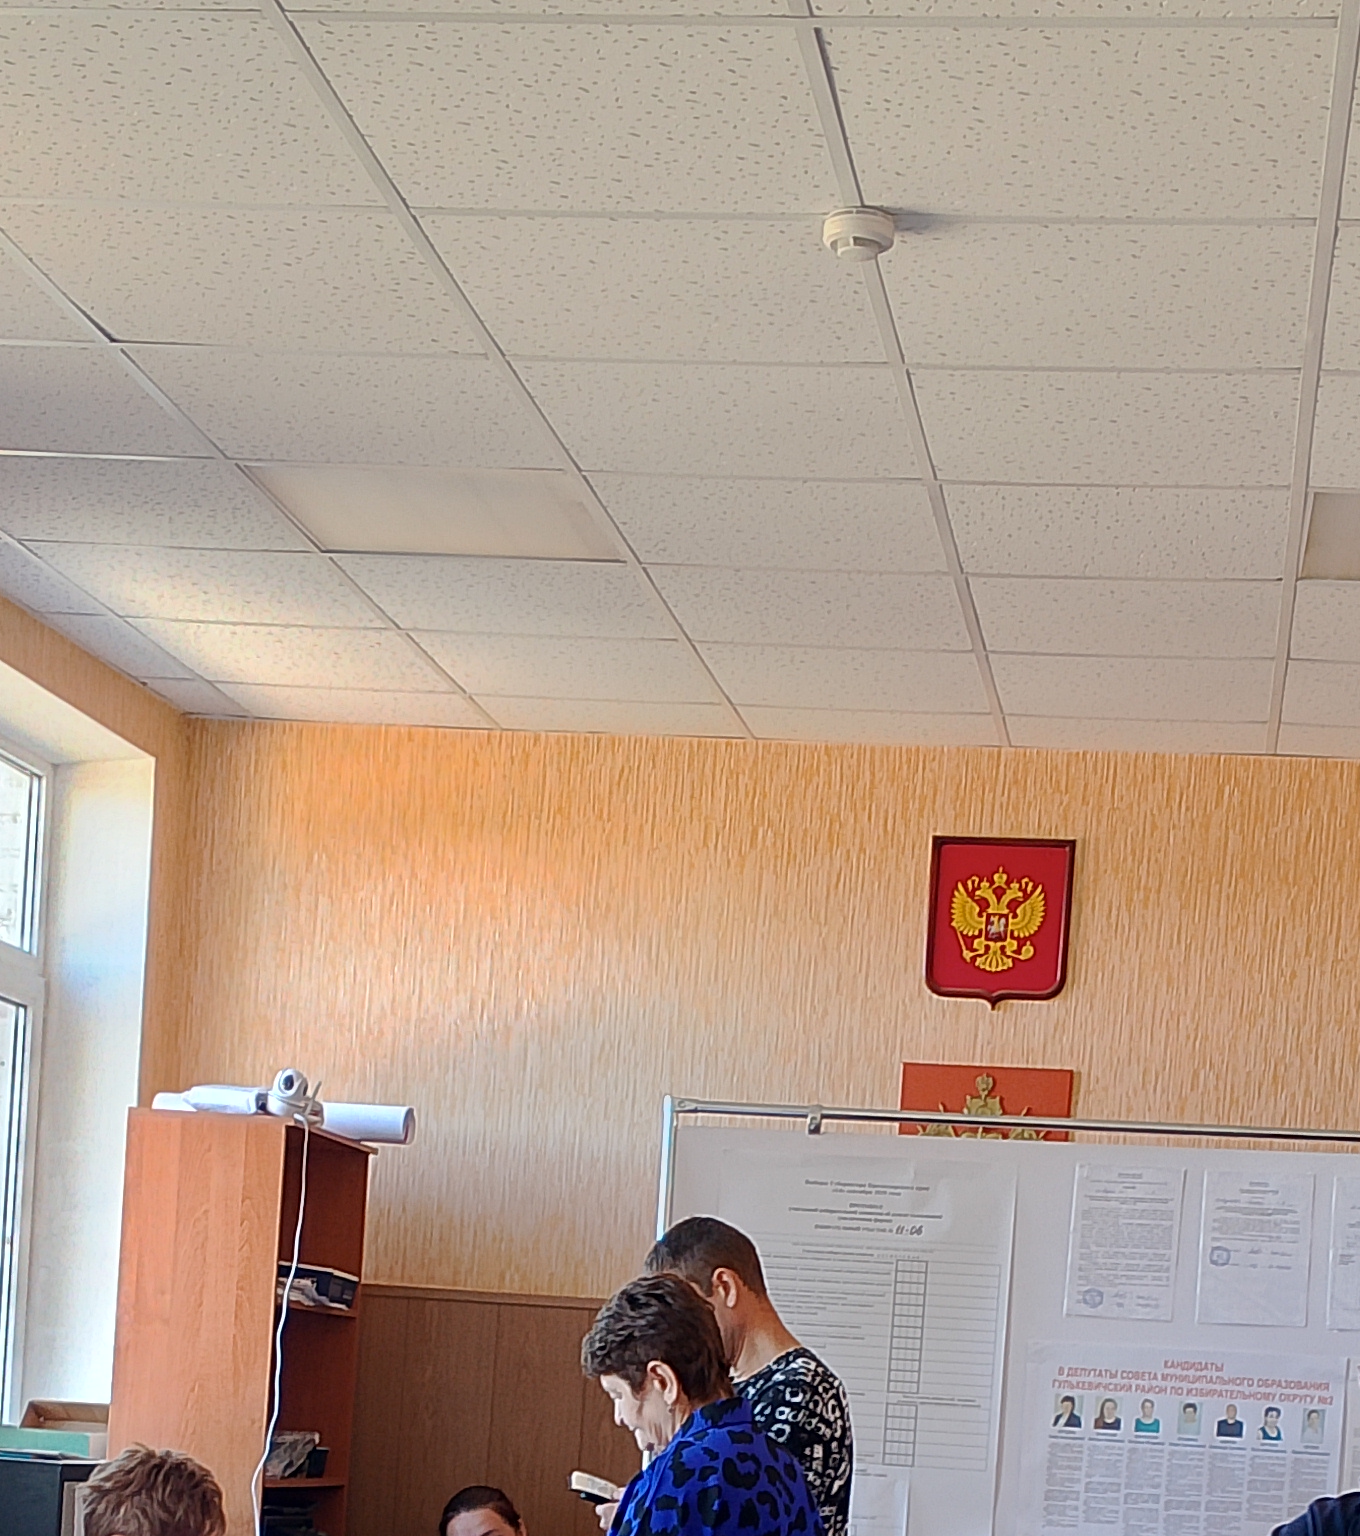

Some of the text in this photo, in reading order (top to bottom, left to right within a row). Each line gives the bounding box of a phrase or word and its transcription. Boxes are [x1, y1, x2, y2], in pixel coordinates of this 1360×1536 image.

[1163, 1360, 1224, 1372] КАНДИДАТЫ
[1058, 1366, 1330, 1391] В ДЕПУТАТЫ СОВЕТА МУНИЦИПАЛЬНОГО ОБРАЗОВАНИЯ
[1135, 1383, 1167, 1395] РАЙОН
[1170, 1386, 1183, 1396] ПО
[1186, 1387, 1277, 1402] ИЗБИРАТЕЛЬНОМУ
[1278, 1393, 1315, 1404] ОКРУГУ
